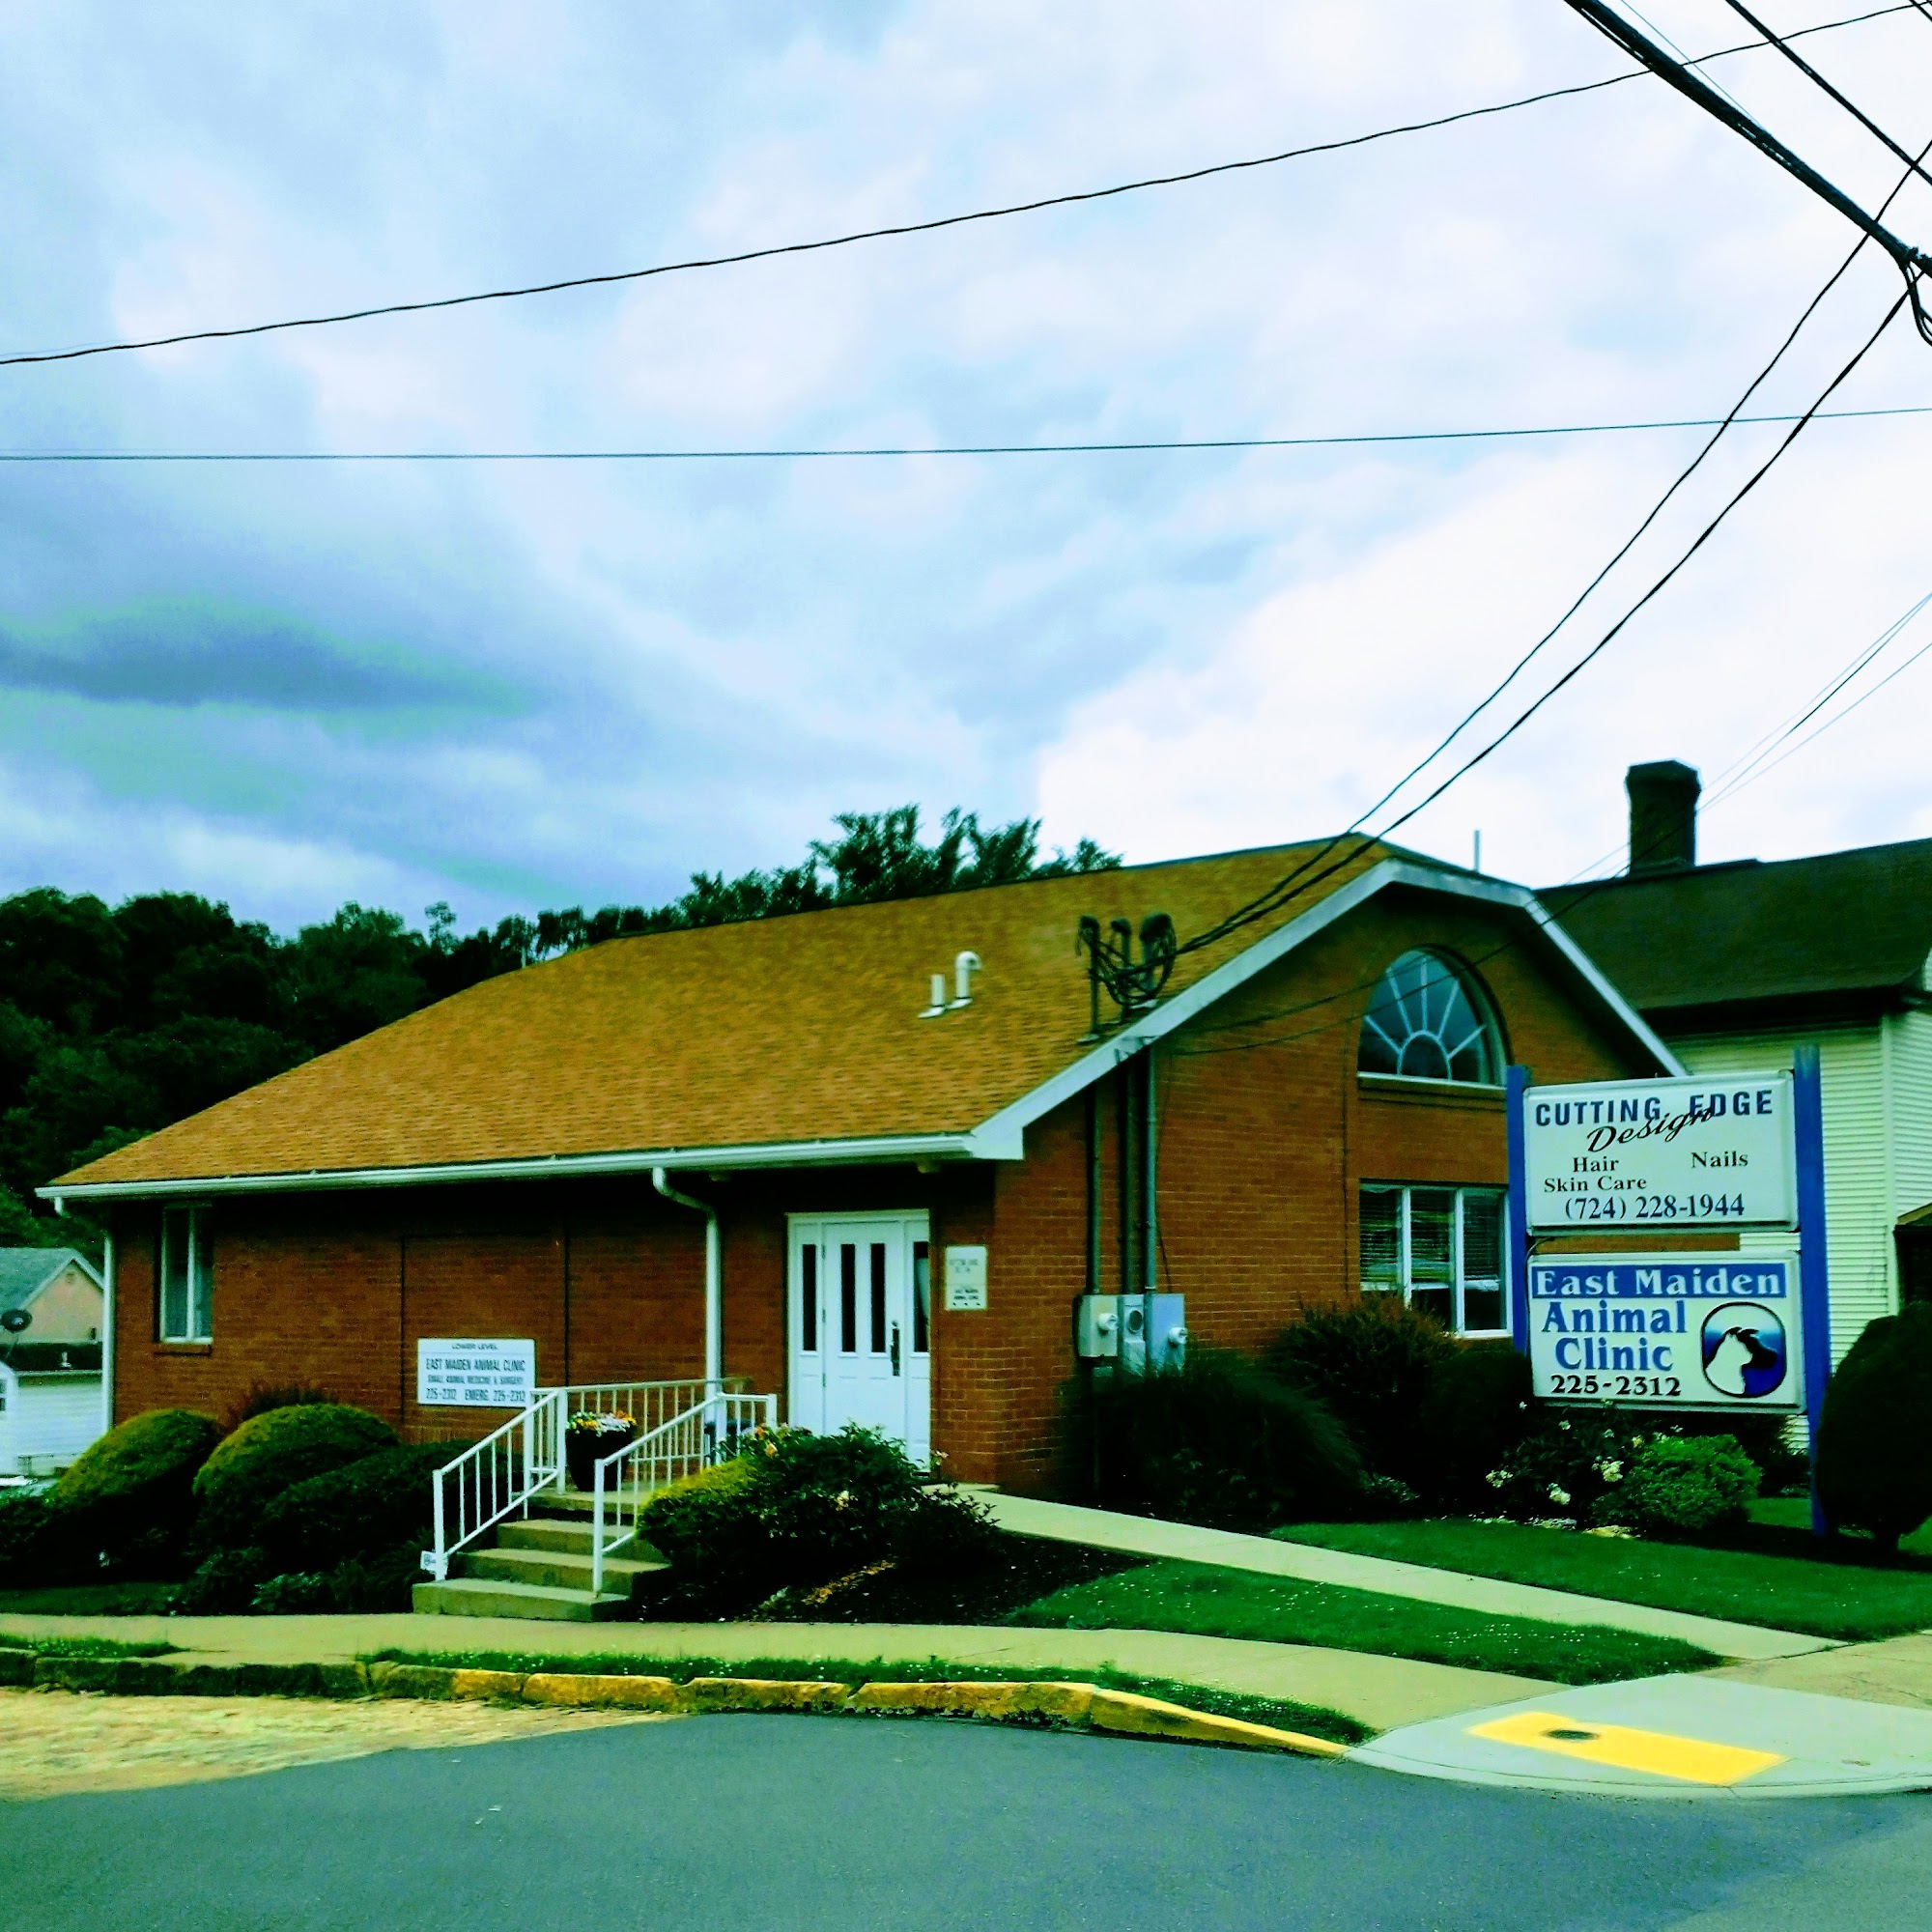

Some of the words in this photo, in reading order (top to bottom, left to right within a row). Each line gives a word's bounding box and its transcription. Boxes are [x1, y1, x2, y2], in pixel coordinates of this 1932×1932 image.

[1535, 1096, 1662, 1127] CUTTING
[1689, 1089, 1774, 1118] EDGE
[1586, 1106, 1717, 1153] Design
[1573, 1156, 1620, 1173] Hair
[1690, 1151, 1749, 1169] Nails
[1544, 1177, 1590, 1193] Skin
[1598, 1175, 1647, 1190] Care
[1565, 1197, 1628, 1220] (724)
[1635, 1193, 1746, 1218] 228-1944
[1536, 1269, 1619, 1295] East
[1635, 1267, 1781, 1294] Maiden
[1541, 1299, 1687, 1333] Animal
[426, 1358, 442, 1371] EAST
[445, 1358, 471, 1371] MAIDEN
[474, 1359, 500, 1372] ANIMAL
[503, 1359, 526, 1372] CLINIC
[1554, 1337, 1674, 1372] Clinic
[1550, 1374, 1682, 1397] 225-2312
